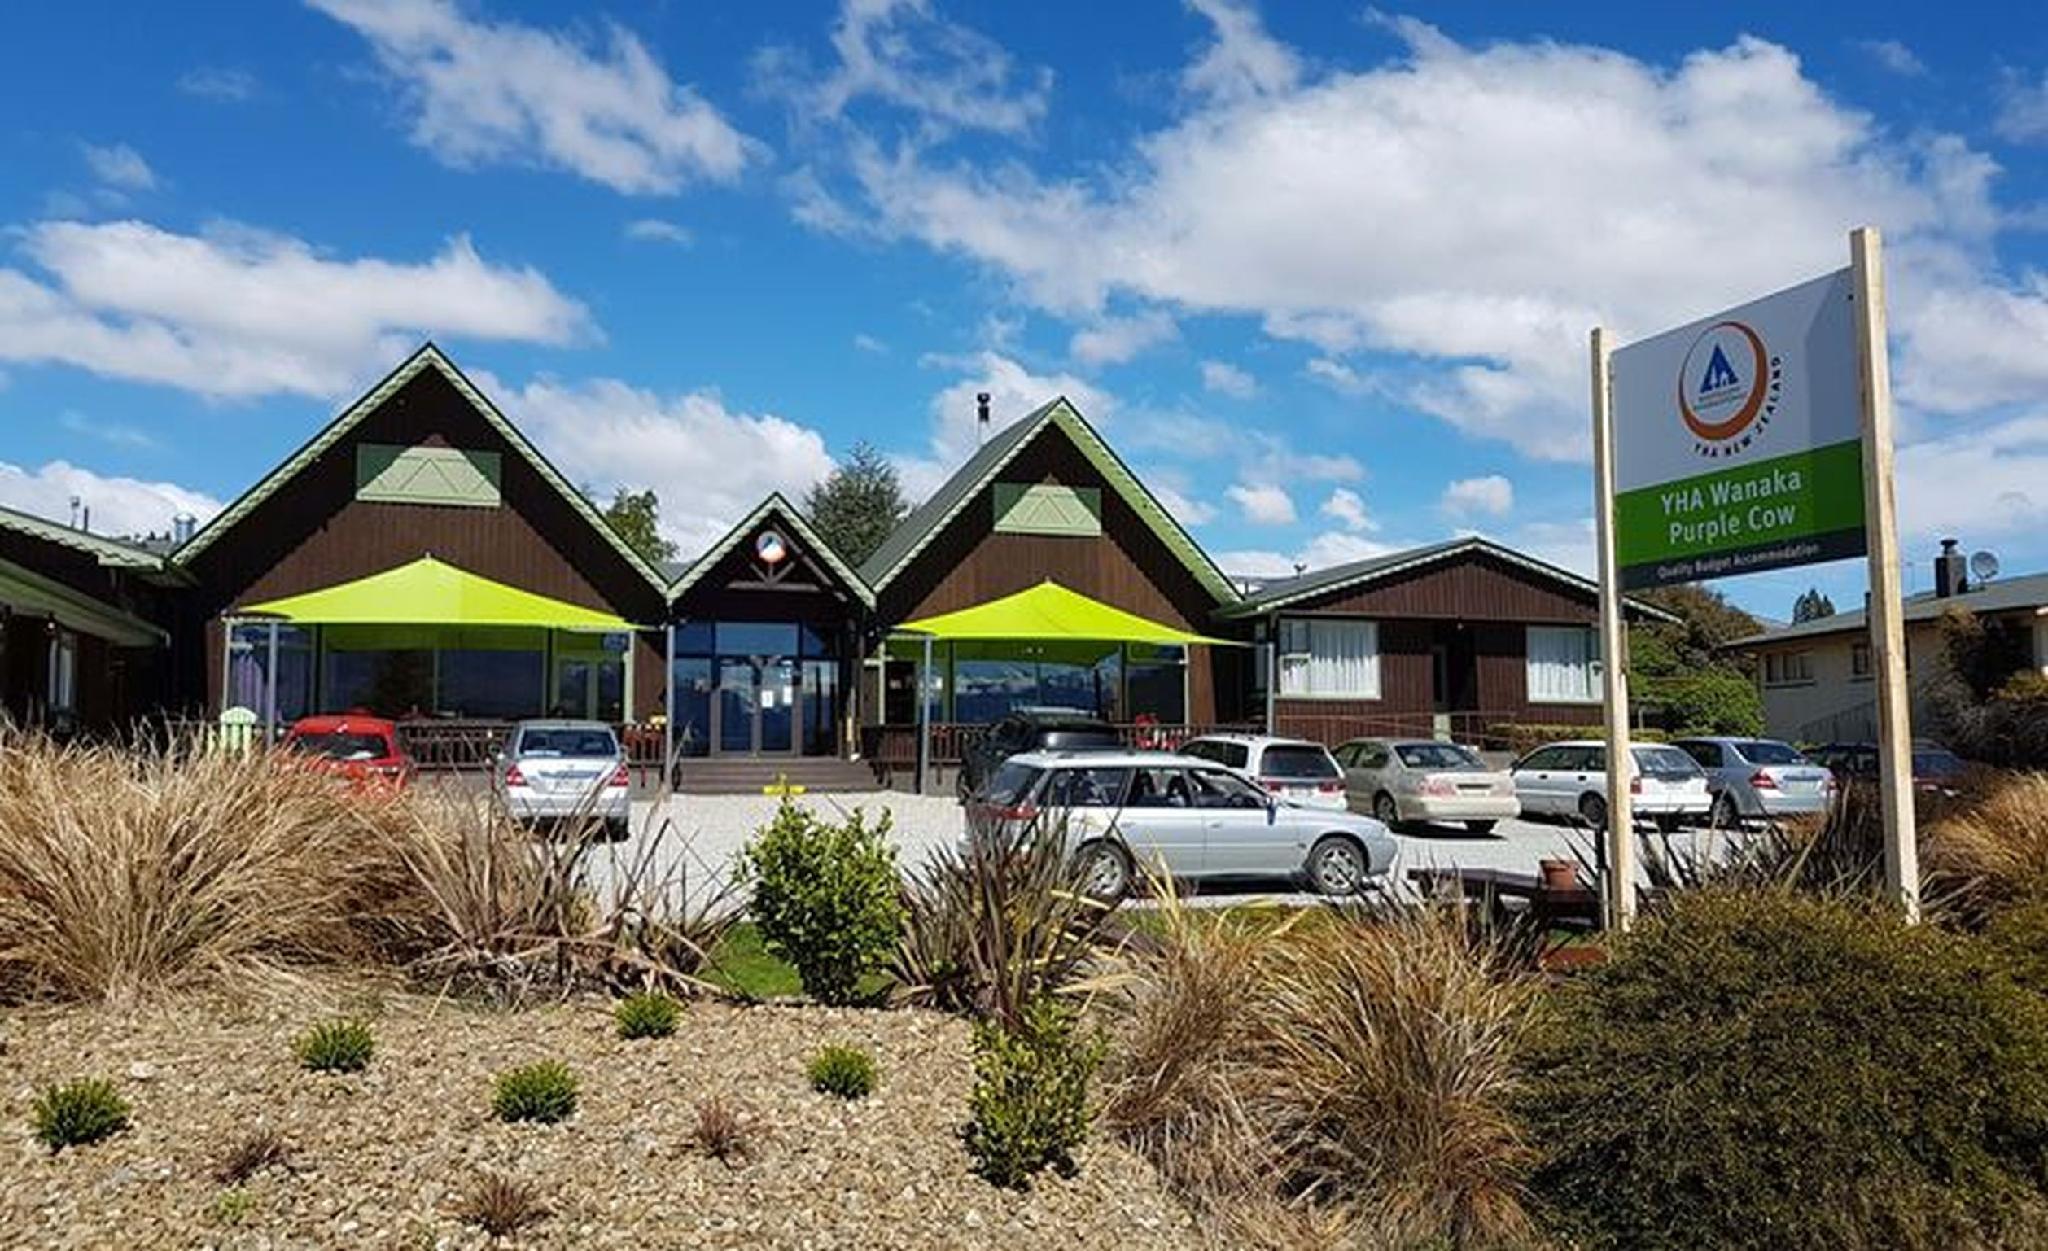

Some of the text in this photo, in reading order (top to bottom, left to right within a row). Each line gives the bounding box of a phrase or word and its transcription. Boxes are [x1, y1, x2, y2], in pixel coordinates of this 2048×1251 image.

[1754, 356, 1782, 436] ZEALAND
[1660, 468, 1802, 515] YHA Wanaka
[1668, 504, 1797, 545] Purple Cow
[1656, 543, 1820, 580] Quality Budget Accommodation
